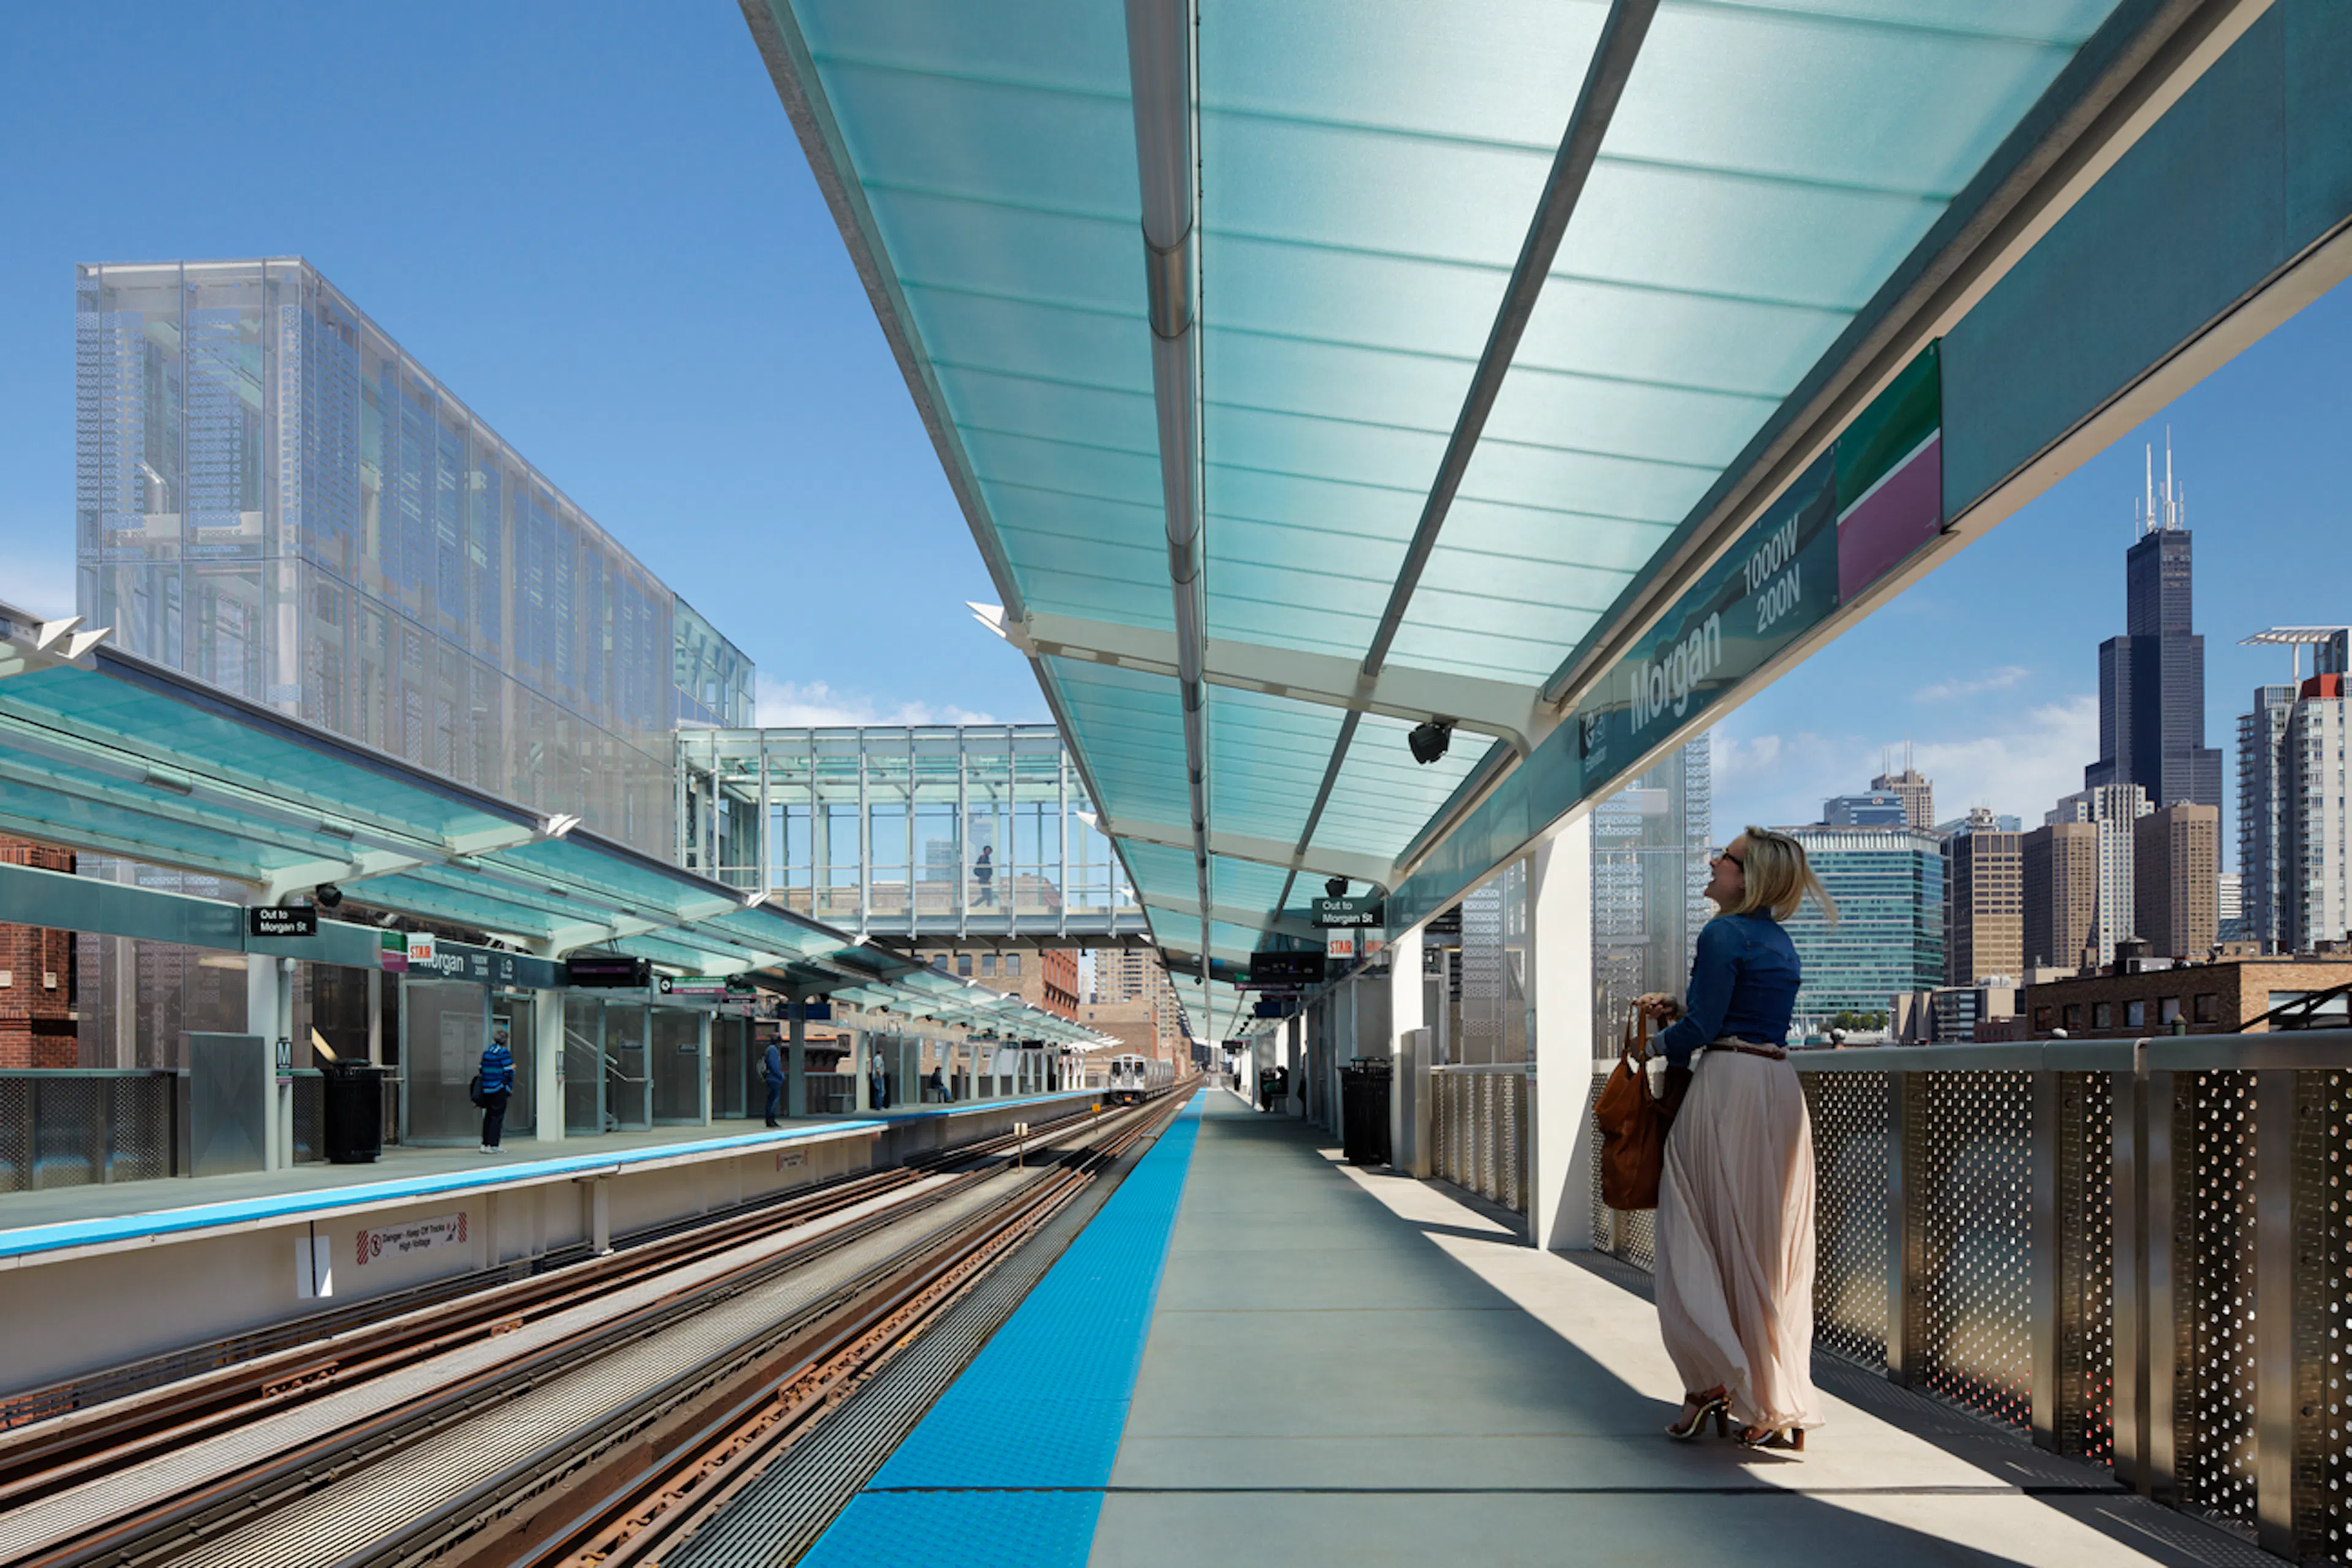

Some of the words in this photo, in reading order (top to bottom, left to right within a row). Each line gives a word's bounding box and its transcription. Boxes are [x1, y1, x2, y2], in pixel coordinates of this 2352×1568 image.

[1743, 512, 1799, 596] 1000W
[1757, 562, 1800, 634] 200N
[1631, 611, 1721, 735] Morgan
[1322, 900, 1341, 910] Out
[1342, 901, 1353, 910] to
[260, 909, 277, 919] Out
[278, 910, 288, 919] to
[1322, 913, 1360, 925] Morgan
[1362, 912, 1373, 923] St
[260, 921, 295, 933] Morgan
[296, 921, 307, 932] St
[410, 946, 431, 958] STAIR
[1330, 940, 1352, 954] STAIR
